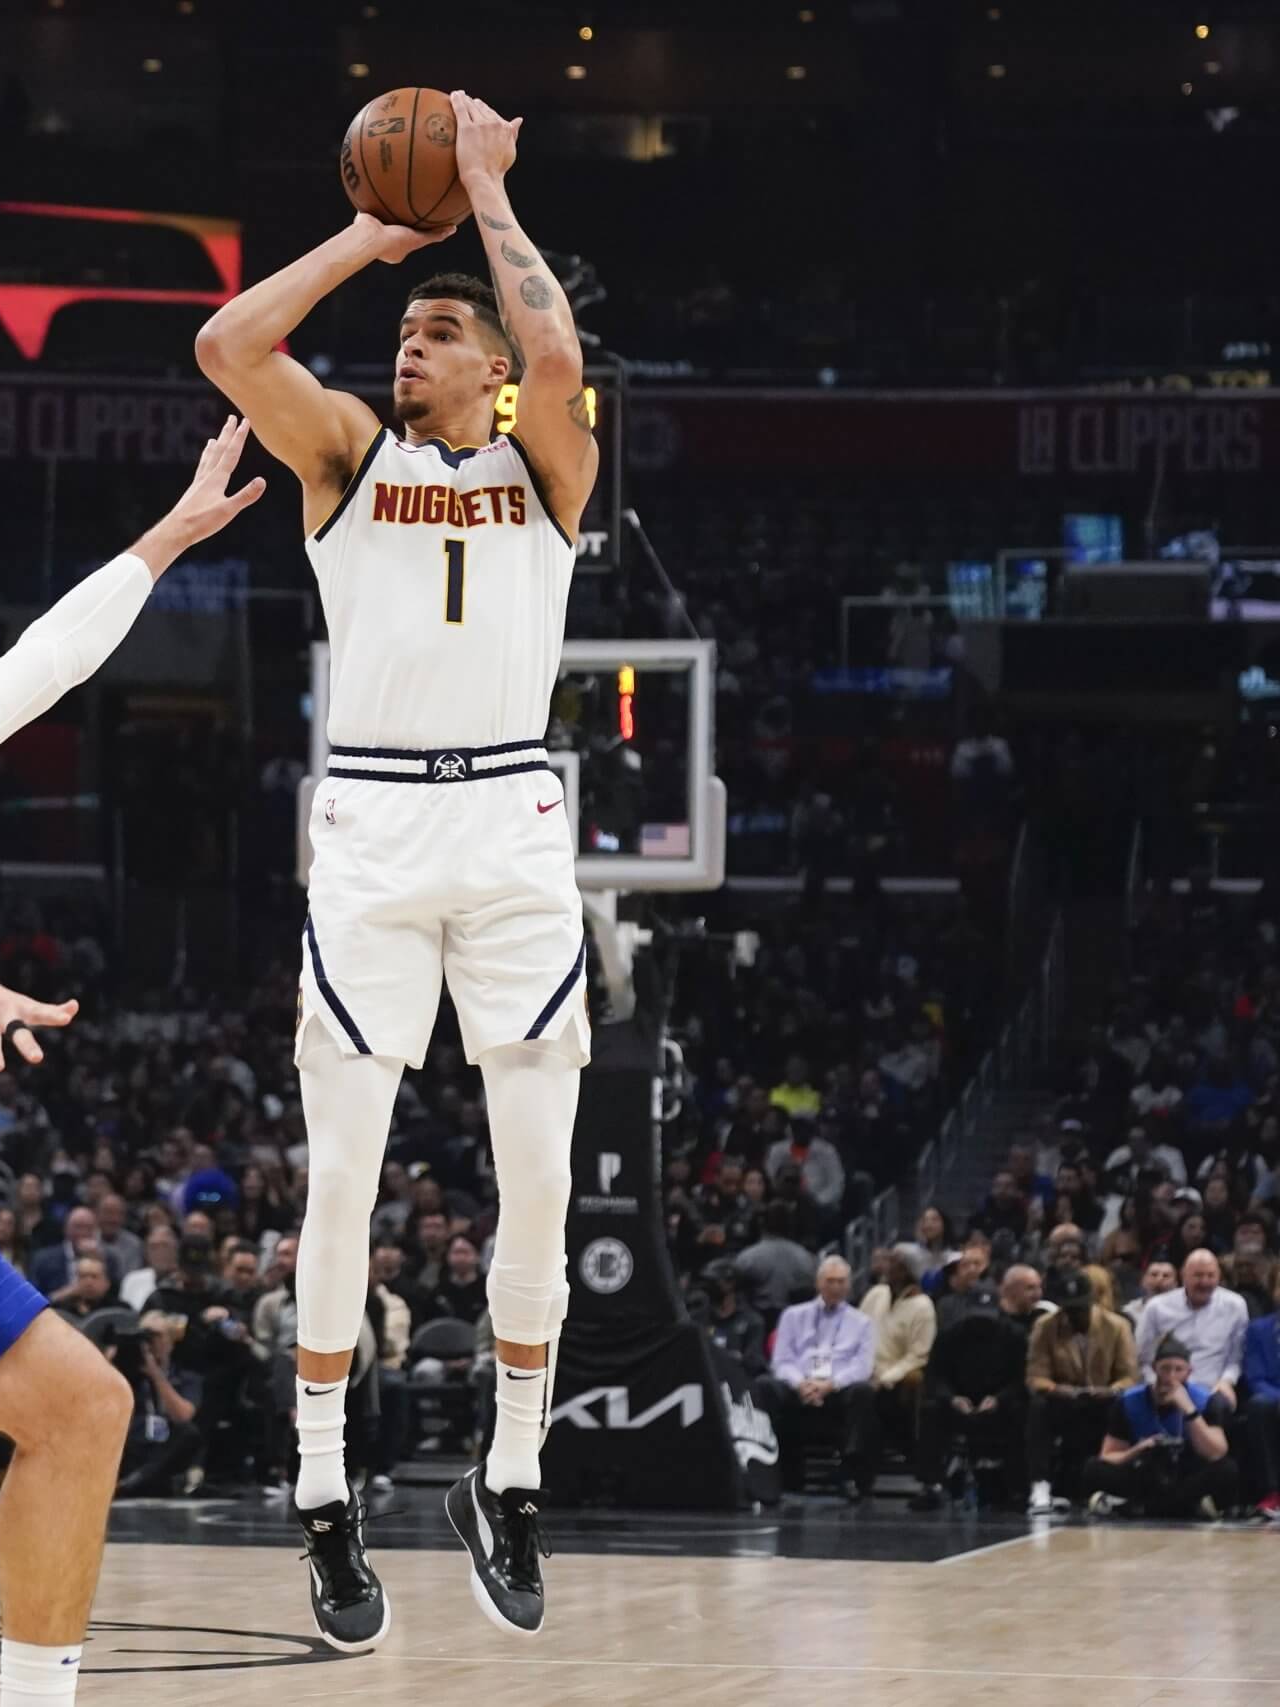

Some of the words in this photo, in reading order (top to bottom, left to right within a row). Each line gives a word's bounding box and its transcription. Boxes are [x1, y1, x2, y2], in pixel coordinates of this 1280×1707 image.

[1070, 404, 1263, 473] CLIPPERS
[372, 481, 527, 529] NUGGETS
[444, 538, 467, 626] 1
[550, 1383, 704, 1430] KIA
